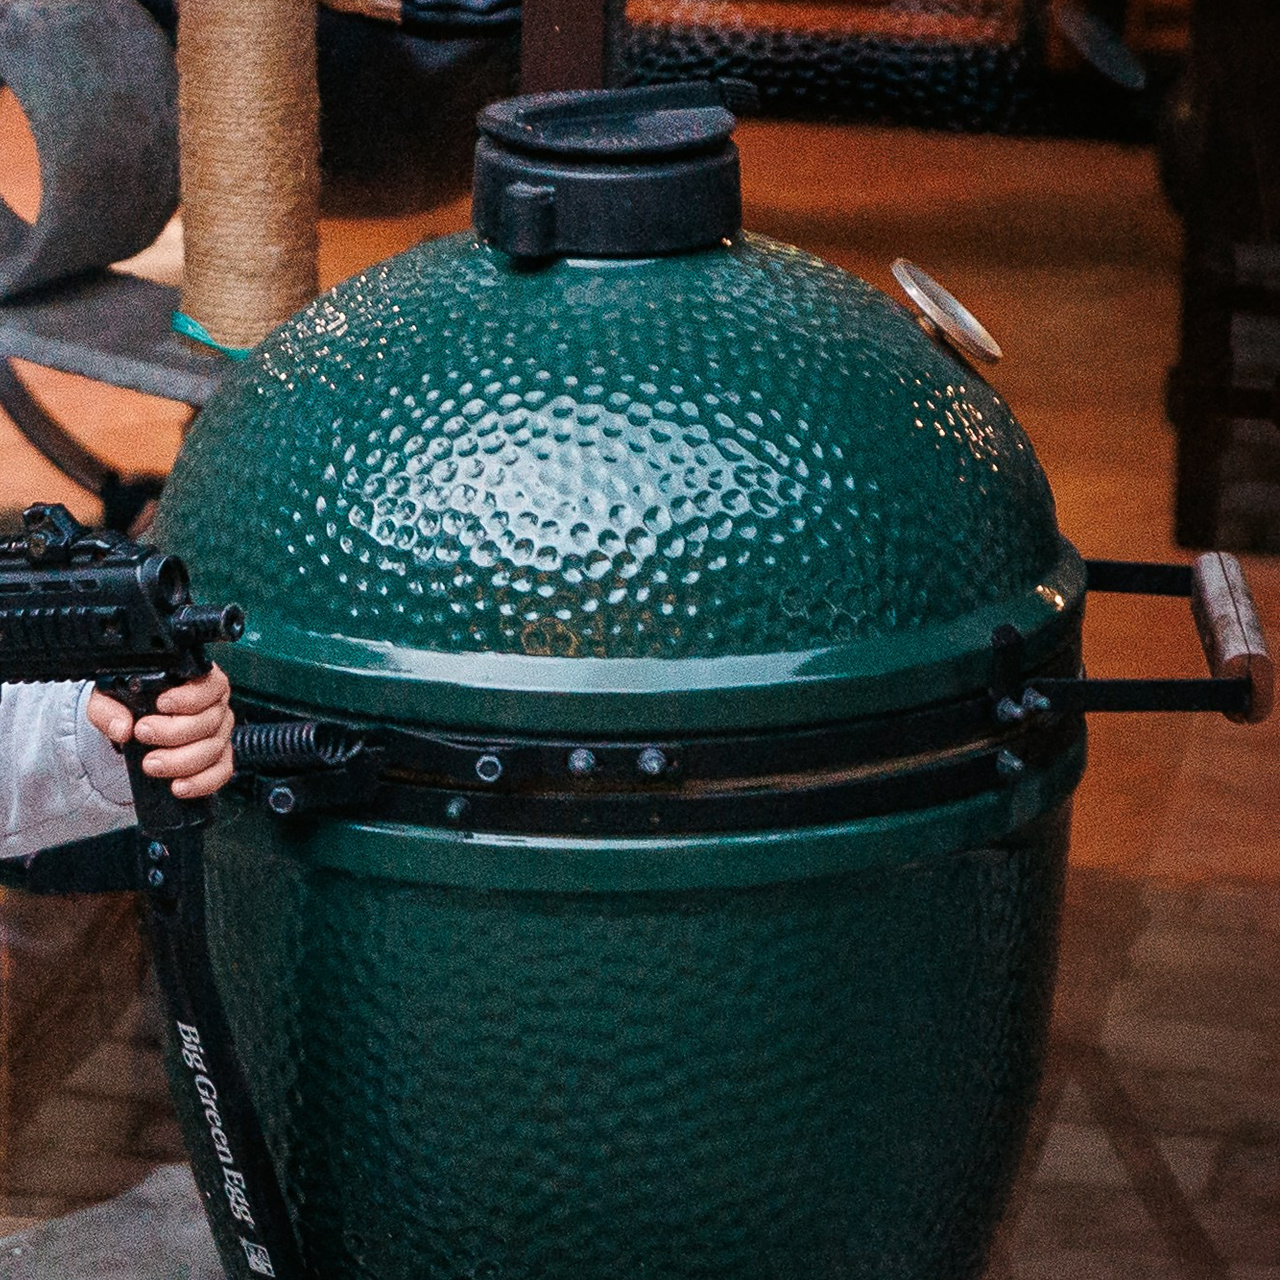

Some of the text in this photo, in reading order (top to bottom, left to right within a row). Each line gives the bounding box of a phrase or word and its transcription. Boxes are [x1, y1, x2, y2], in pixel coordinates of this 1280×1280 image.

[176, 1020, 256, 1229] Big Green Egg
